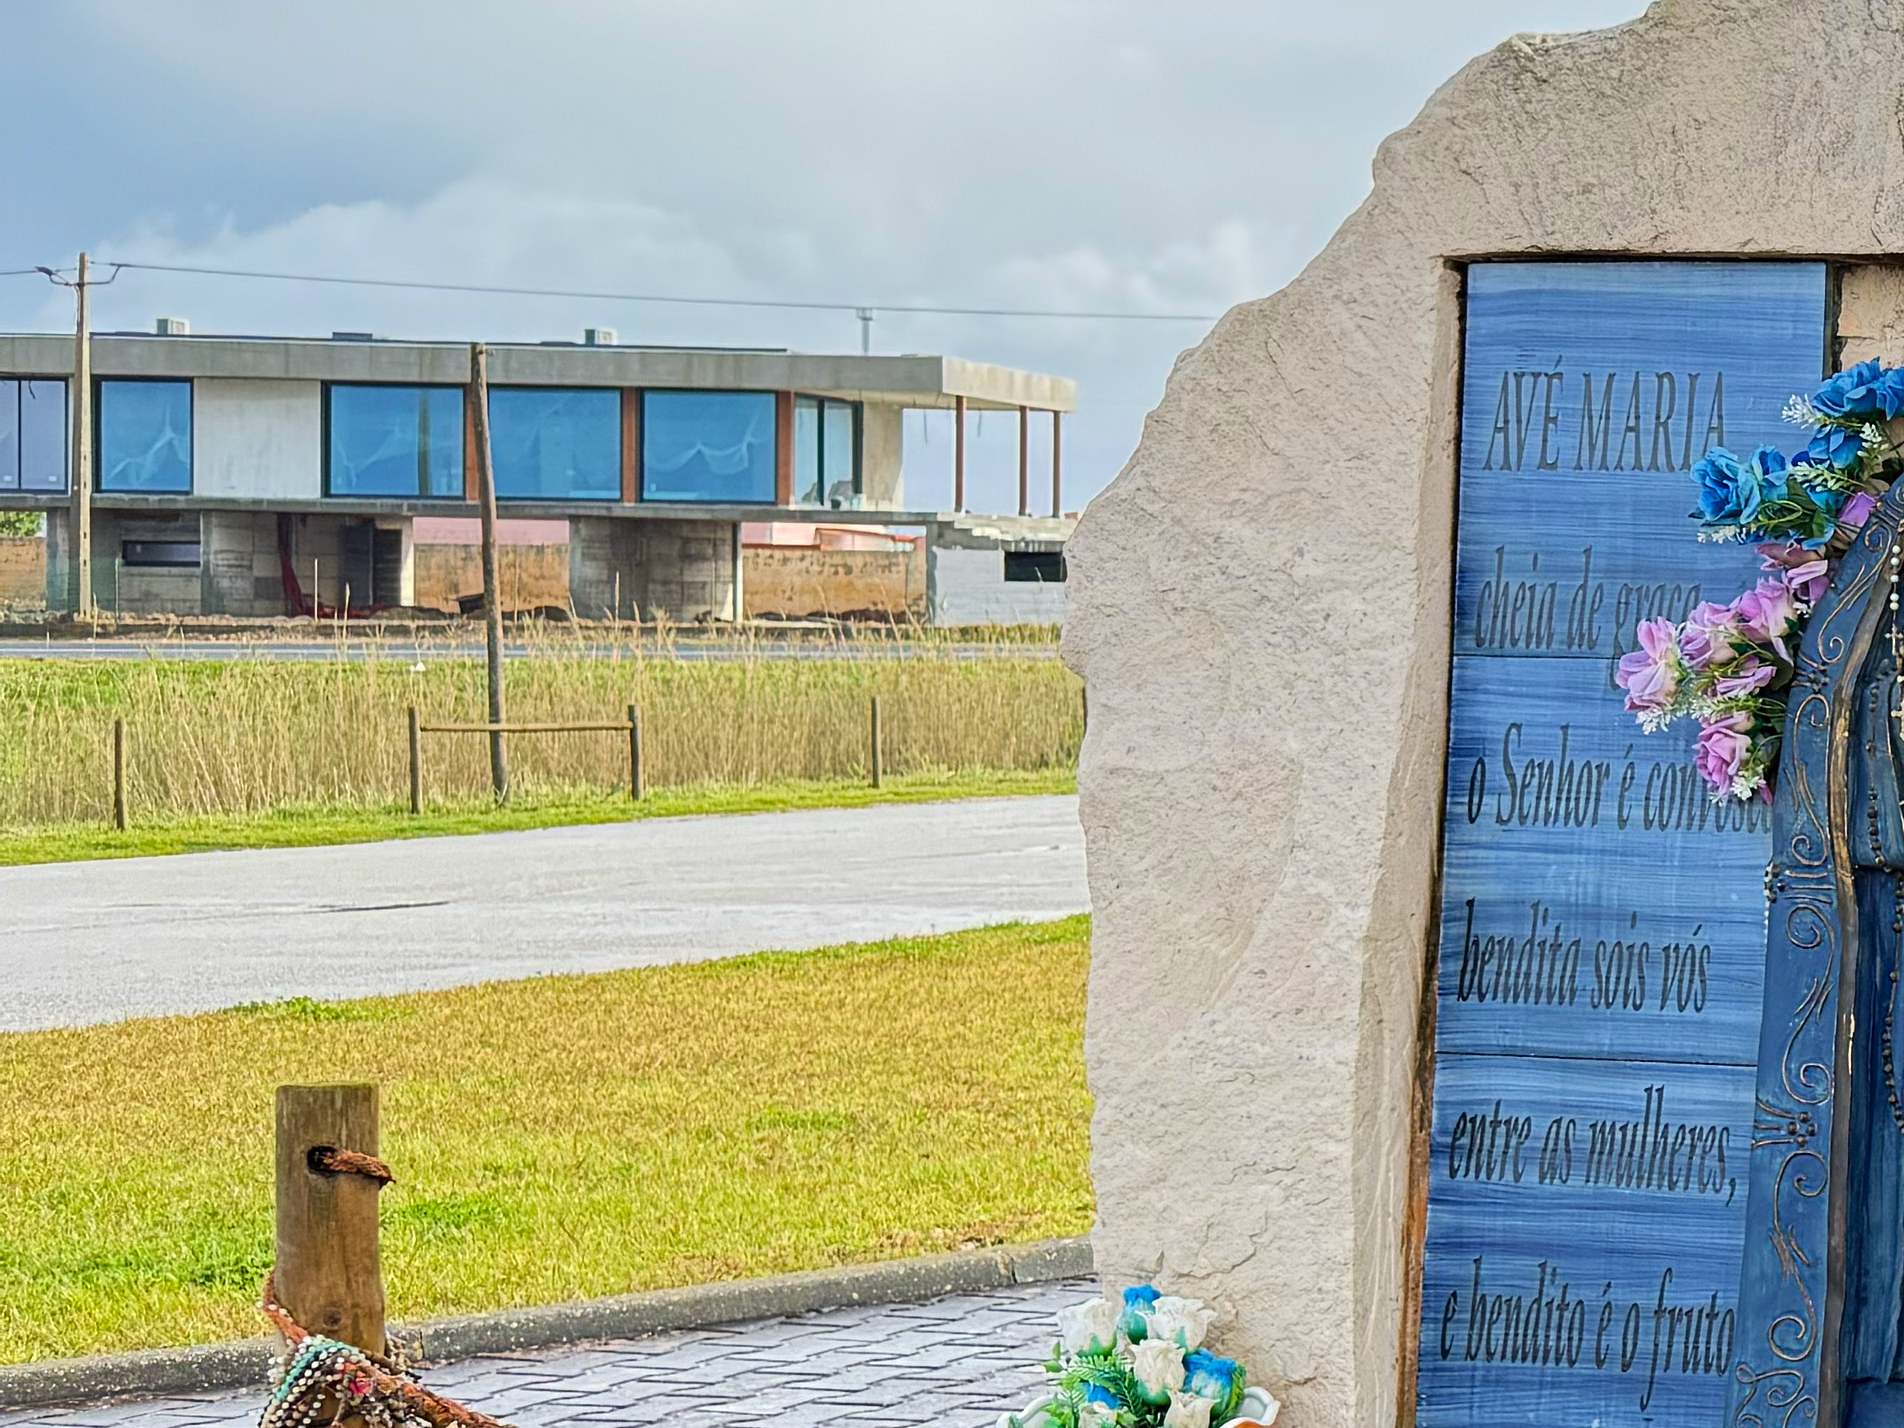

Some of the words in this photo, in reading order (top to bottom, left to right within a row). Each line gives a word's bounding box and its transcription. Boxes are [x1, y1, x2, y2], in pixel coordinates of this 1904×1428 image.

[1483, 354, 1564, 472] AVÉ
[1573, 370, 1724, 473] MARIA
[1474, 544, 1557, 649] cheia
[1567, 544, 1604, 651] de
[1467, 756, 1486, 825] o
[1495, 722, 1610, 828] Senhor
[1617, 743, 1637, 831] é
[1456, 896, 1581, 1006] bendita
[1591, 910, 1650, 1012] sois
[1659, 923, 1711, 1013] vós
[1449, 1098, 1532, 1183] entre
[1538, 1116, 1576, 1184] as
[1585, 1084, 1737, 1207] mulheres,
[1440, 1289, 1458, 1361] e
[1464, 1255, 1585, 1368] bendito
[1594, 1281, 1613, 1370] é
[1621, 1302, 1640, 1373] o
[1639, 1267, 1736, 1412] fruto
